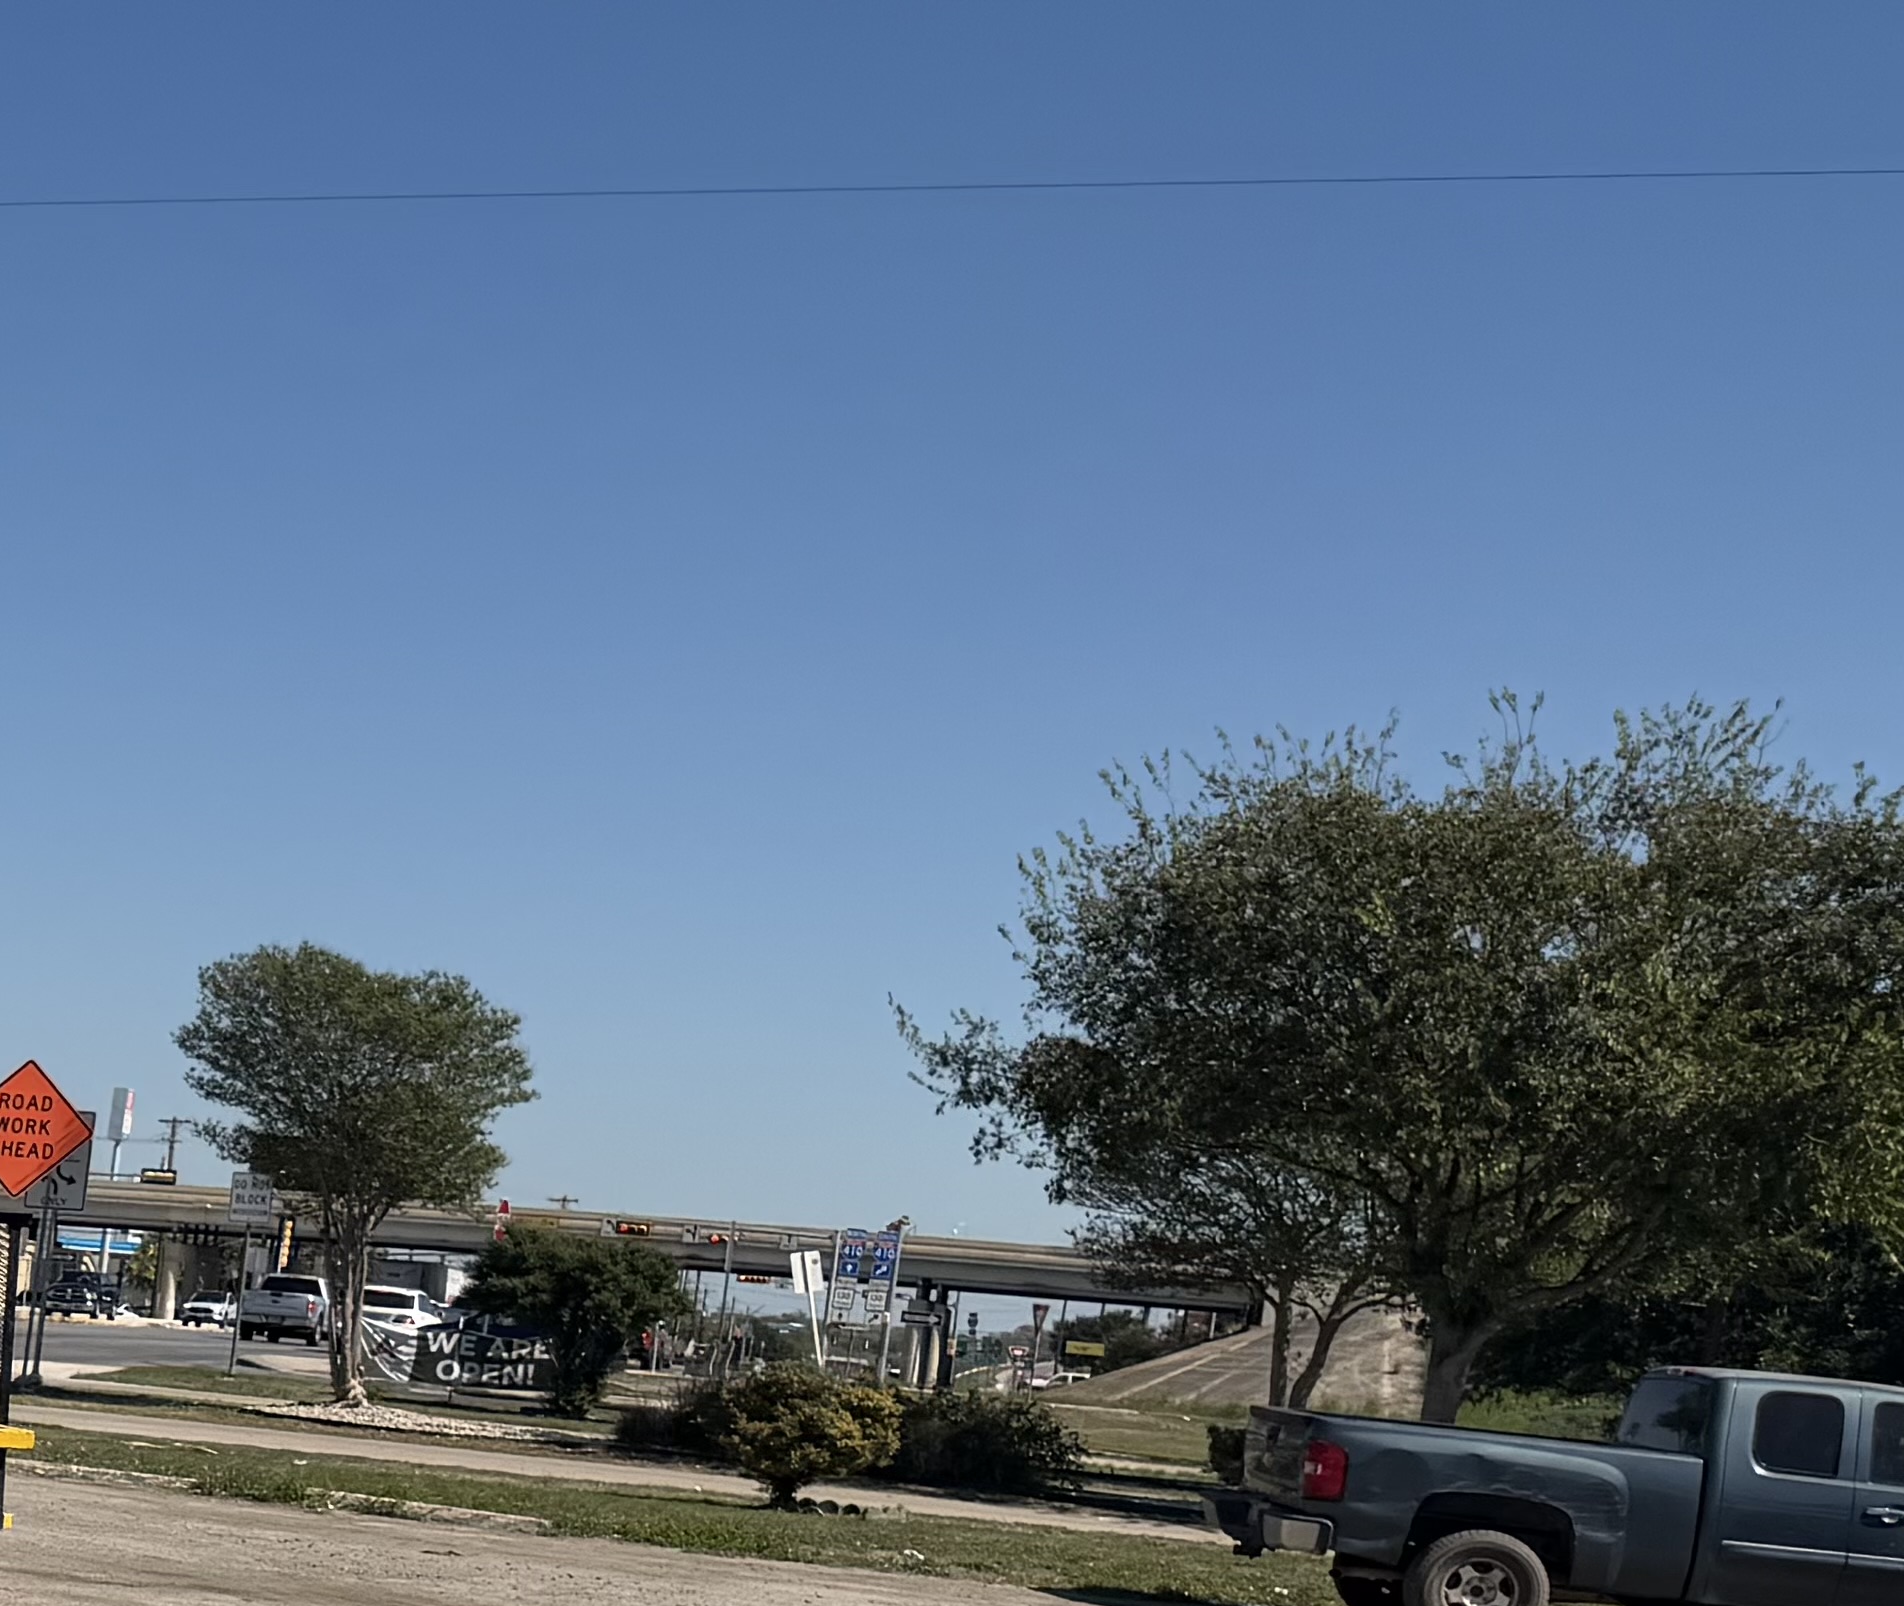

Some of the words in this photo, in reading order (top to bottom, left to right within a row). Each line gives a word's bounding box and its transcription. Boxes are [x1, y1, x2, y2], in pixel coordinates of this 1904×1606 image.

[235, 1193, 267, 1205] BLOCK
[427, 1331, 478, 1356] WE
[486, 1338, 551, 1360] ARE
[435, 1359, 536, 1385] OPEN!
